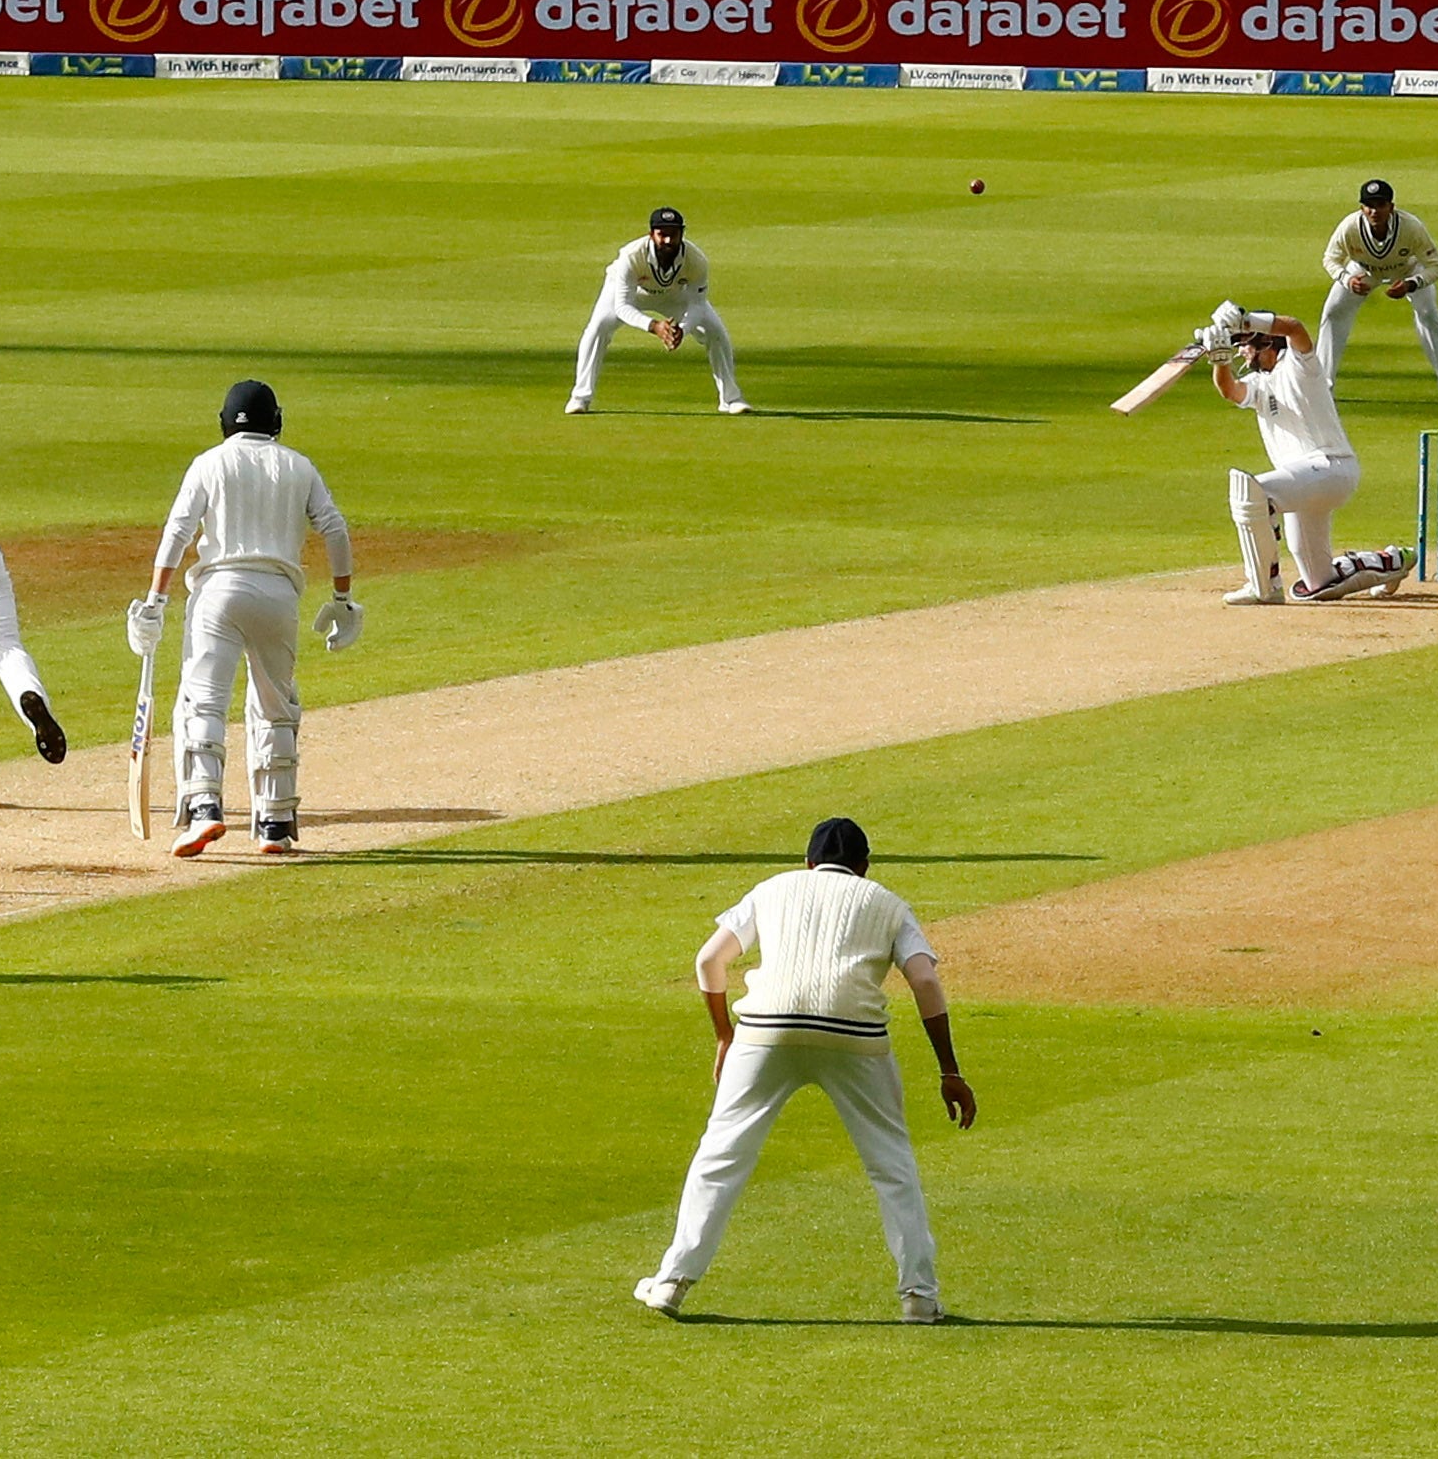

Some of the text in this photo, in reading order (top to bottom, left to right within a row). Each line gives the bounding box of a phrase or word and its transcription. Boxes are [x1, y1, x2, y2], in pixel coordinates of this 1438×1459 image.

[167, 59, 260, 72] In With Heart
[412, 63, 517, 75] LV.com/insurance
[738, 71, 765, 79] Home
[909, 70, 1012, 83] LV.com/insurance
[1160, 74, 1252, 86] In With Heart
